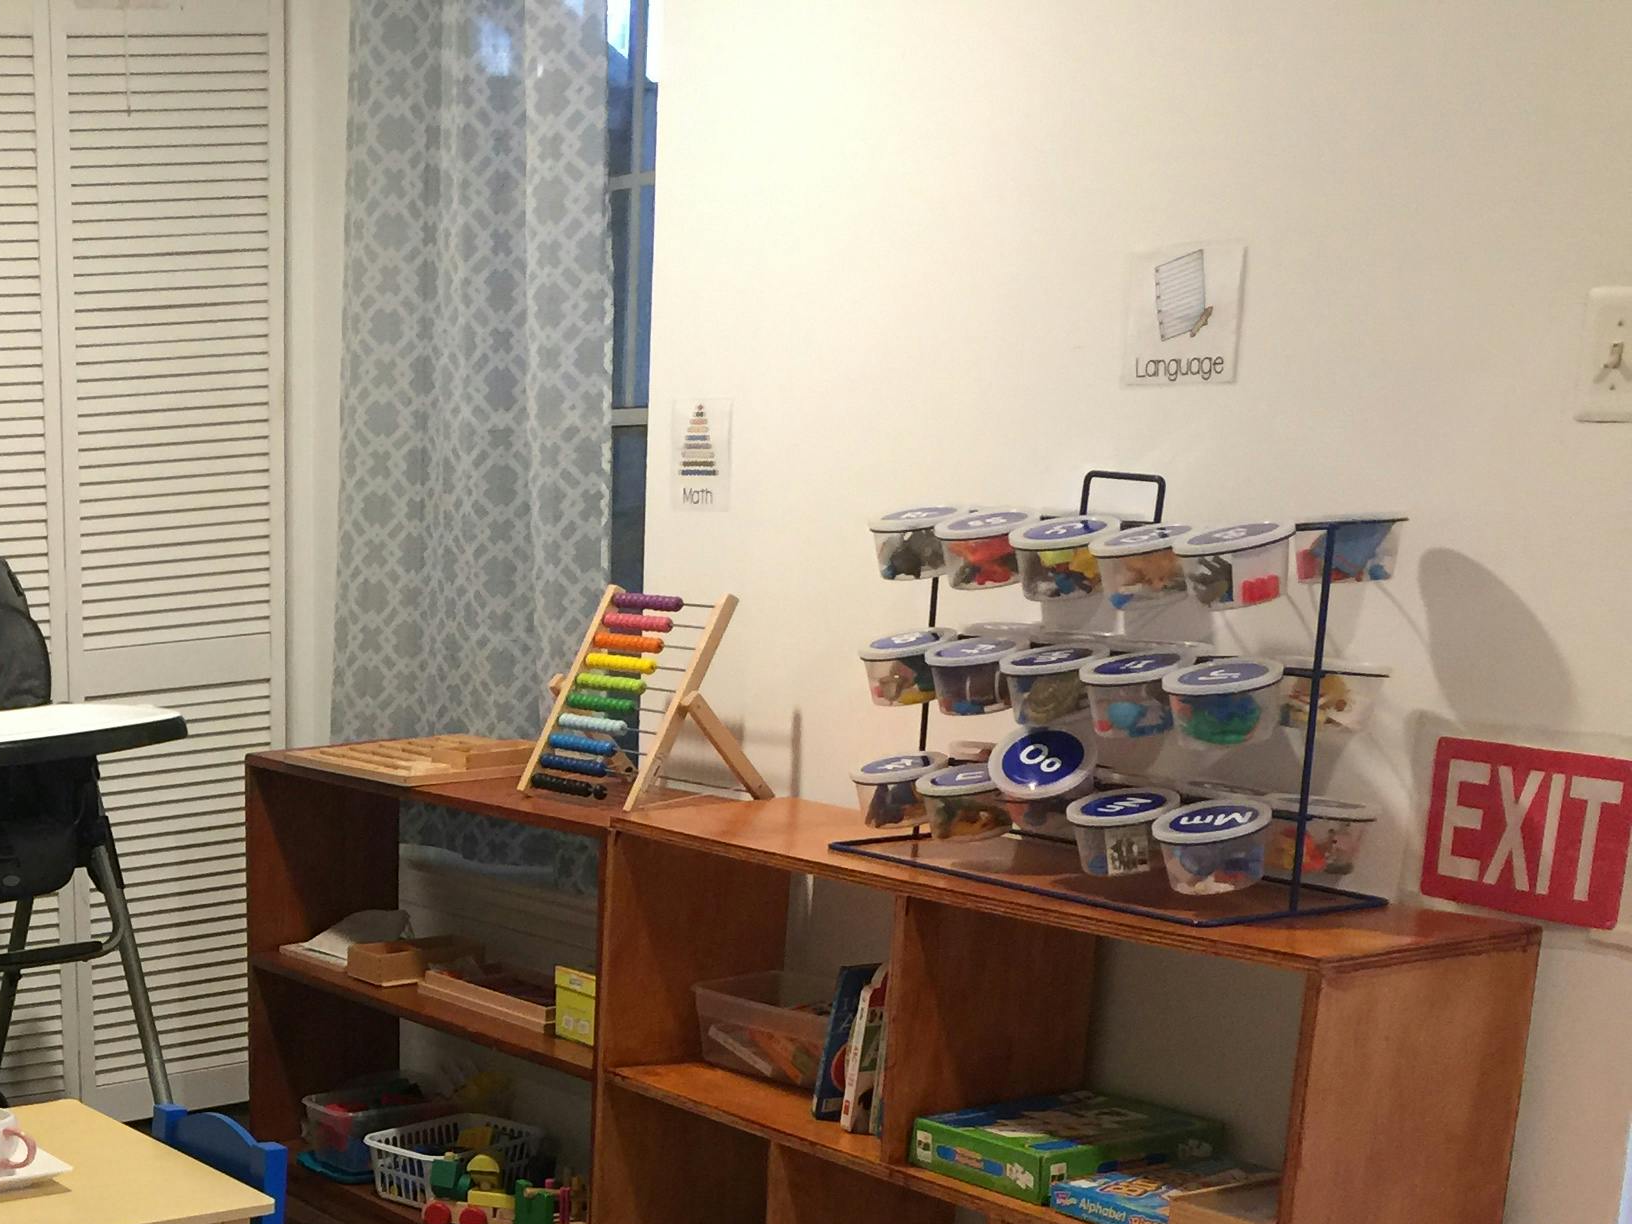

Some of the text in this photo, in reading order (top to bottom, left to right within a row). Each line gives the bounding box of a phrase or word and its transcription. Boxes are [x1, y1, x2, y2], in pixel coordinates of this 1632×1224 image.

[1135, 355, 1225, 382] Language
[682, 487, 713, 504] Math
[1019, 743, 1062, 773] Oo
[1179, 810, 1254, 827] Mm
[1437, 758, 1624, 902] EXIT
[1079, 1197, 1127, 1222] Alphabet
